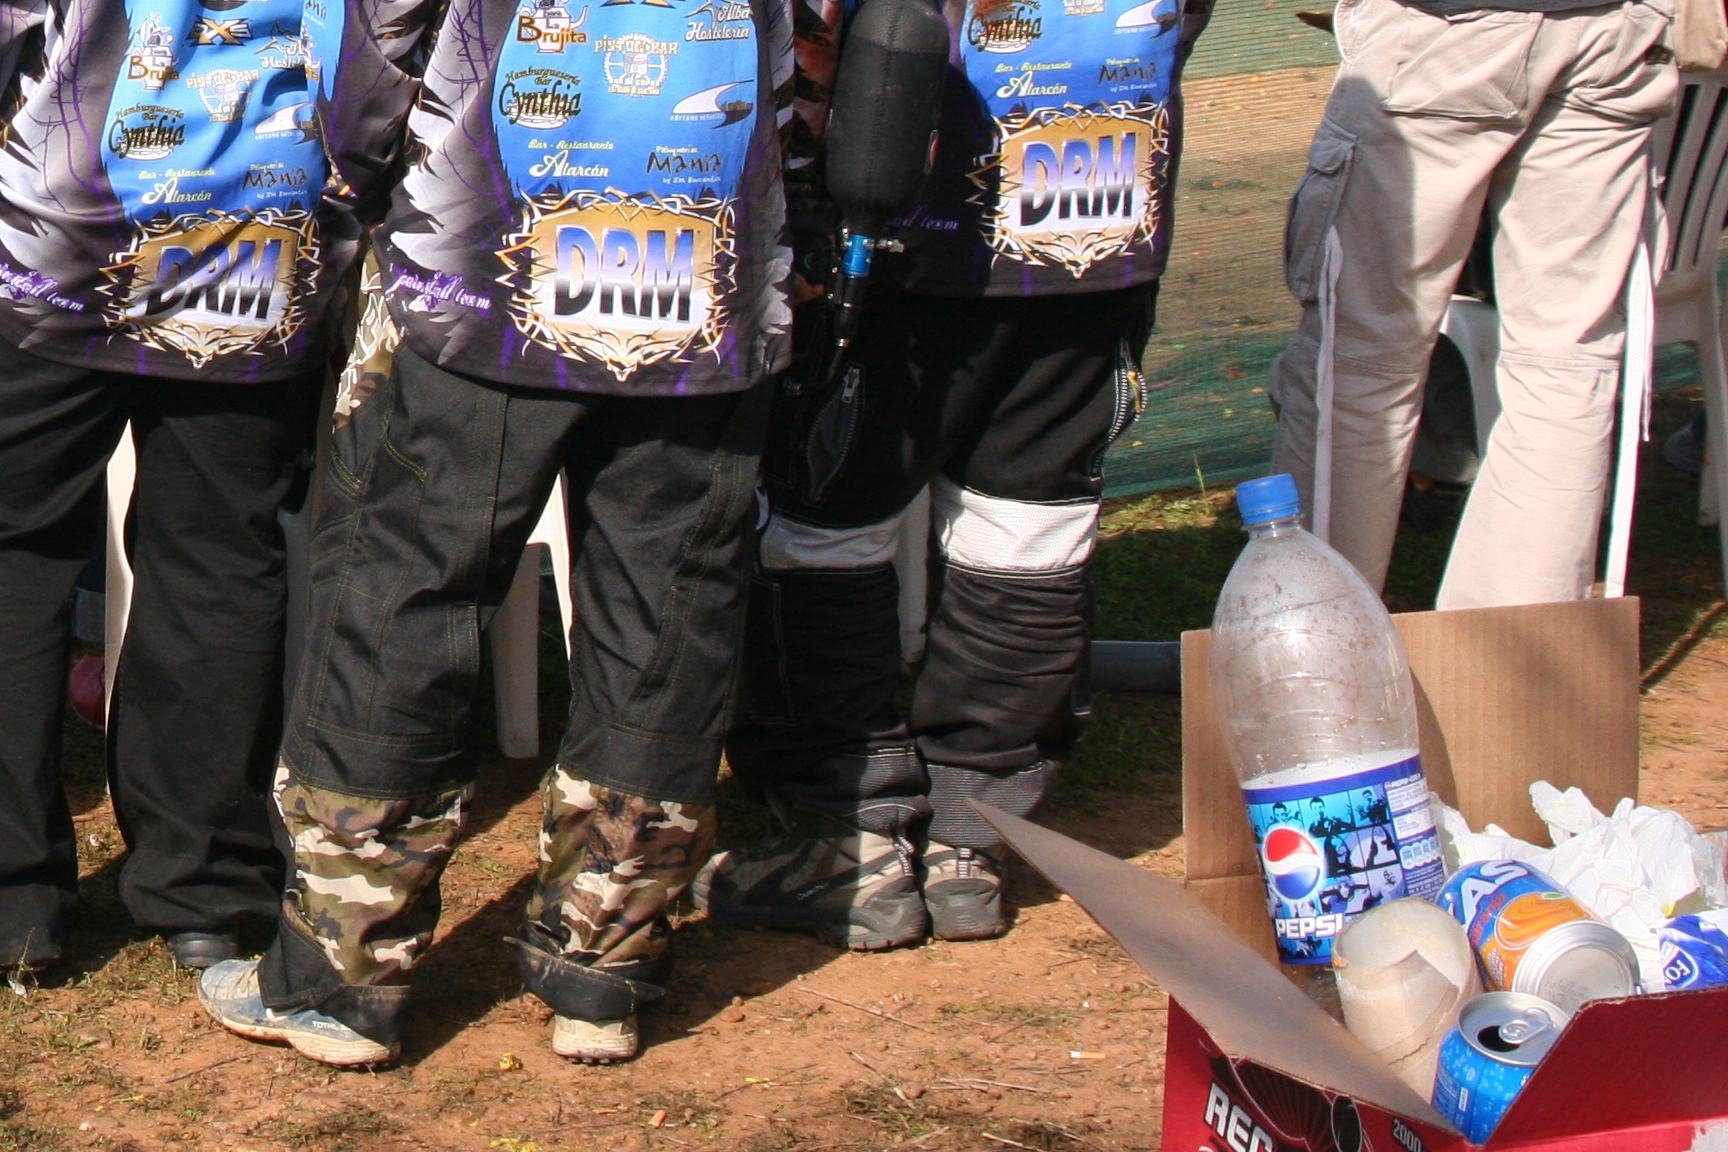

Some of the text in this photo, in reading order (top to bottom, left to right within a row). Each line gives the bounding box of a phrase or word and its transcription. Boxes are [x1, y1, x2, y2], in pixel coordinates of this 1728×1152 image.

[717, 3, 752, 22] Alba
[516, 14, 588, 53] Brujita
[967, 6, 1043, 52] Cynthia
[650, 40, 680, 56] BAR
[996, 71, 1068, 99] Alarcón
[1098, 62, 1158, 86] Mania
[499, 79, 582, 125] Cynthia
[108, 114, 186, 160] Cynthia
[527, 138, 548, 150] Bar
[528, 149, 610, 178] Alarcón
[646, 152, 721, 175] Mania
[141, 177, 213, 205] Alarcón
[242, 168, 310, 191] Mania
[1019, 132, 1138, 228] DRM
[145, 237, 284, 320] DRM
[553, 224, 695, 323] DRM
[1275, 913, 1344, 940] PEPSI
[1392, 1118, 1422, 1152] 2000
